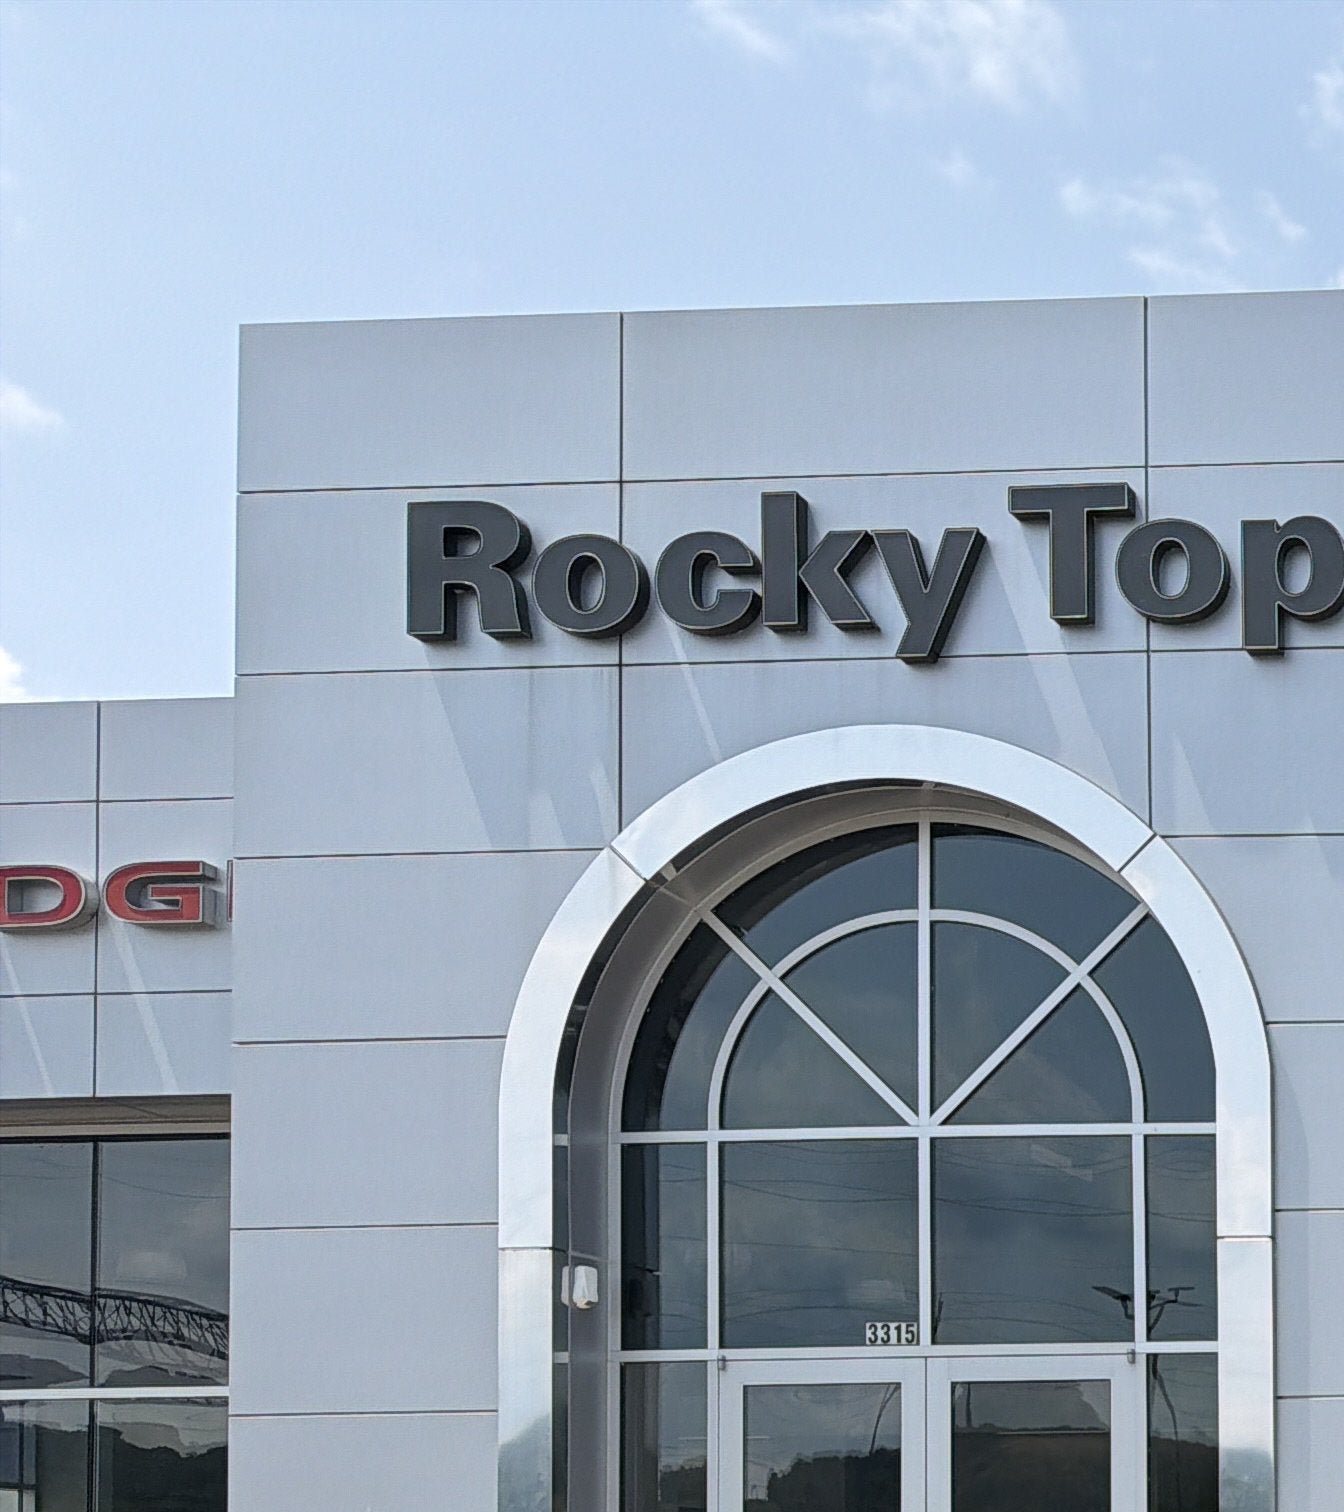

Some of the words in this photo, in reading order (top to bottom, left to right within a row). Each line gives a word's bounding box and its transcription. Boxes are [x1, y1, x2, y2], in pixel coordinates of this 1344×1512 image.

[406, 491, 988, 663] Rocky
[0, 860, 233, 930] DG
[868, 1323, 915, 1344] 3315
